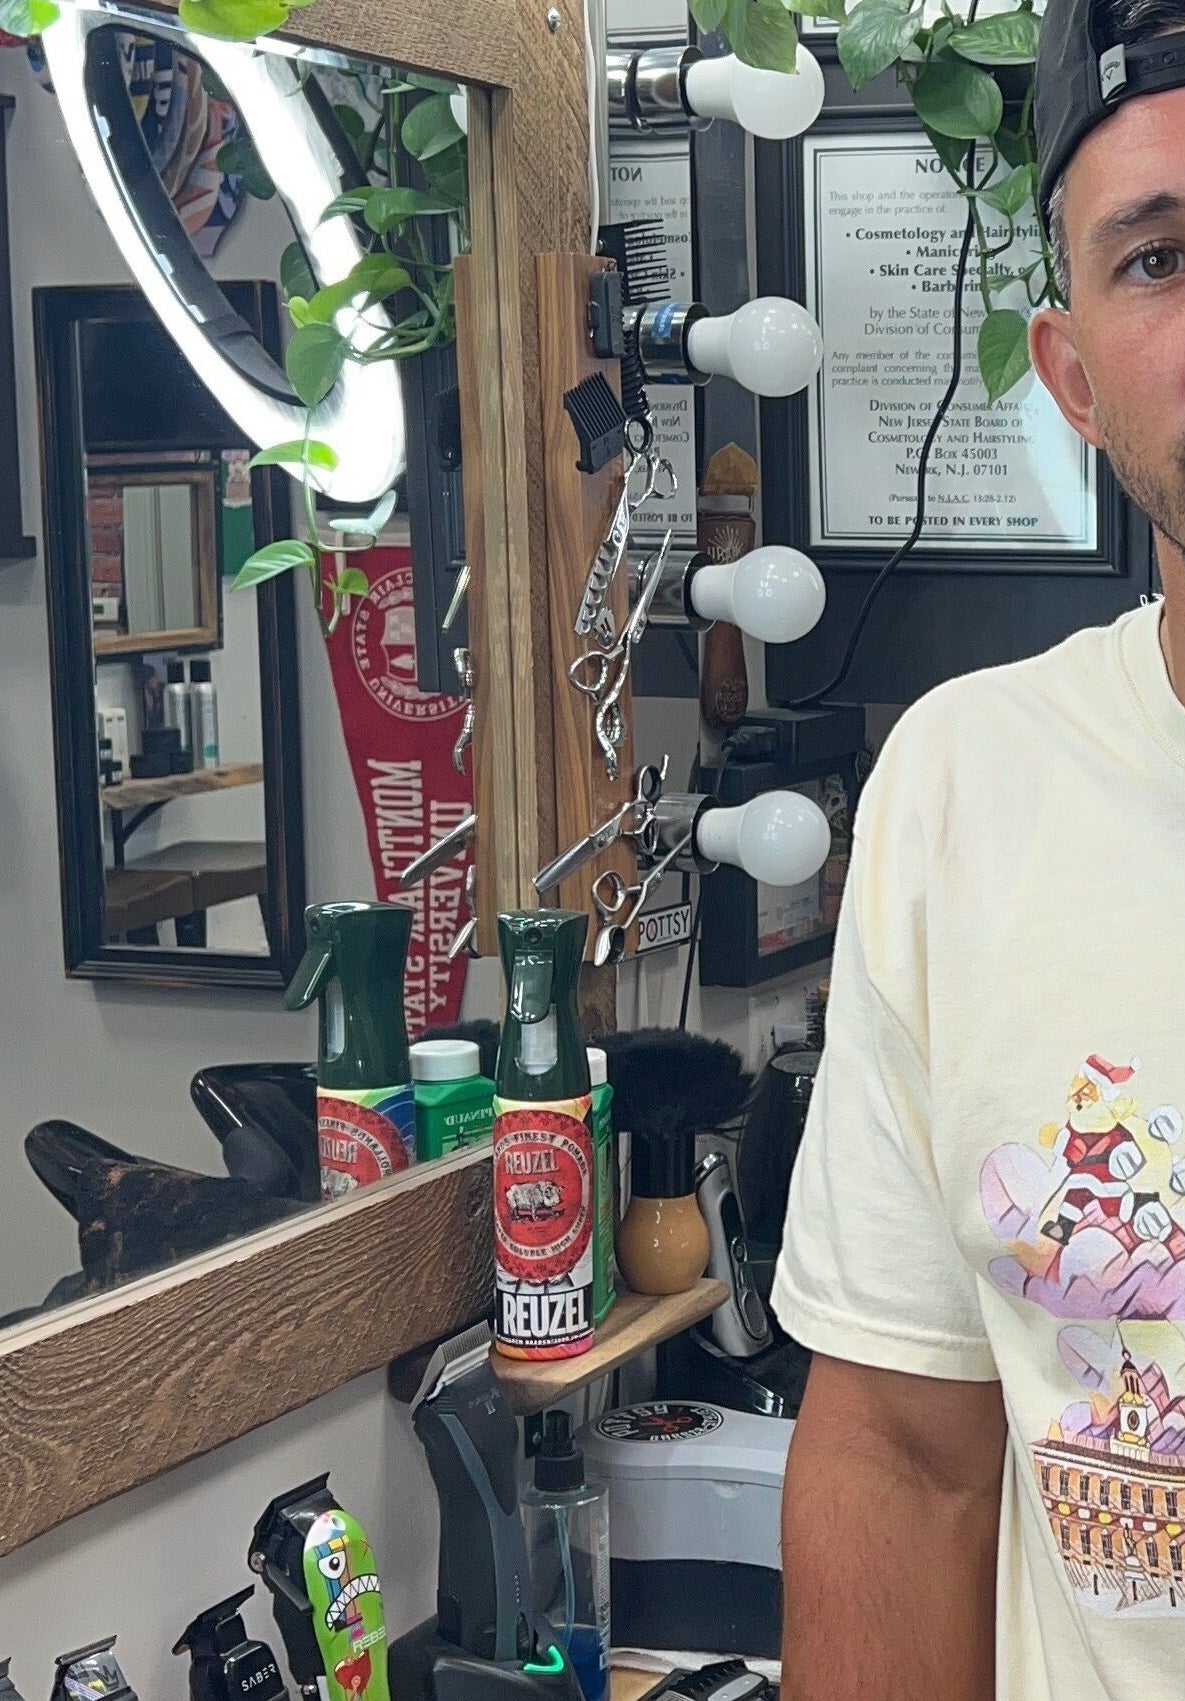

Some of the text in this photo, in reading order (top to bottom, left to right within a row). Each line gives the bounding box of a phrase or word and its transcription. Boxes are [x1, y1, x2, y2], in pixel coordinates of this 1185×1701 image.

[915, 157, 985, 174] NOE
[830, 191, 847, 201] This
[851, 191, 874, 203] shop
[878, 191, 896, 199] and
[900, 191, 915, 199] the
[828, 206, 862, 216] engage
[865, 205, 874, 214] in
[877, 204, 890, 213] the
[895, 204, 933, 215] practice
[855, 227, 946, 242] Cosmetology
[951, 229, 975, 238] an
[879, 264, 909, 277] Skin
[914, 265, 948, 276] Care
[870, 306, 884, 322] by
[888, 306, 906, 319] the
[910, 307, 940, 319] State
[865, 323, 913, 336] Division
[917, 323, 930, 335] of
[832, 351, 849, 362] Any
[856, 351, 894, 360] member
[900, 350, 909, 360] of
[915, 351, 930, 360] the
[832, 364, 878, 374] complaint
[884, 364, 937, 375] concerning
[943, 364, 954, 372] th
[832, 377, 869, 388] practice
[872, 376, 879, 385] is
[882, 376, 931, 385] conducted
[907, 416, 935, 428] JERSE
[962, 448, 998, 459] 45003
[895, 463, 1007, 476] NEWRK, N.J. 07101
[869, 516, 883, 525] TO
[887, 516, 900, 525] BE
[953, 516, 965, 526] IN
[969, 516, 1001, 526] EVERY
[1007, 517, 1039, 527] SHOP
[504, 1148, 560, 1175] REUZEL
[502, 1289, 589, 1338] REUZEL
[241, 1662, 277, 1693] SABER
